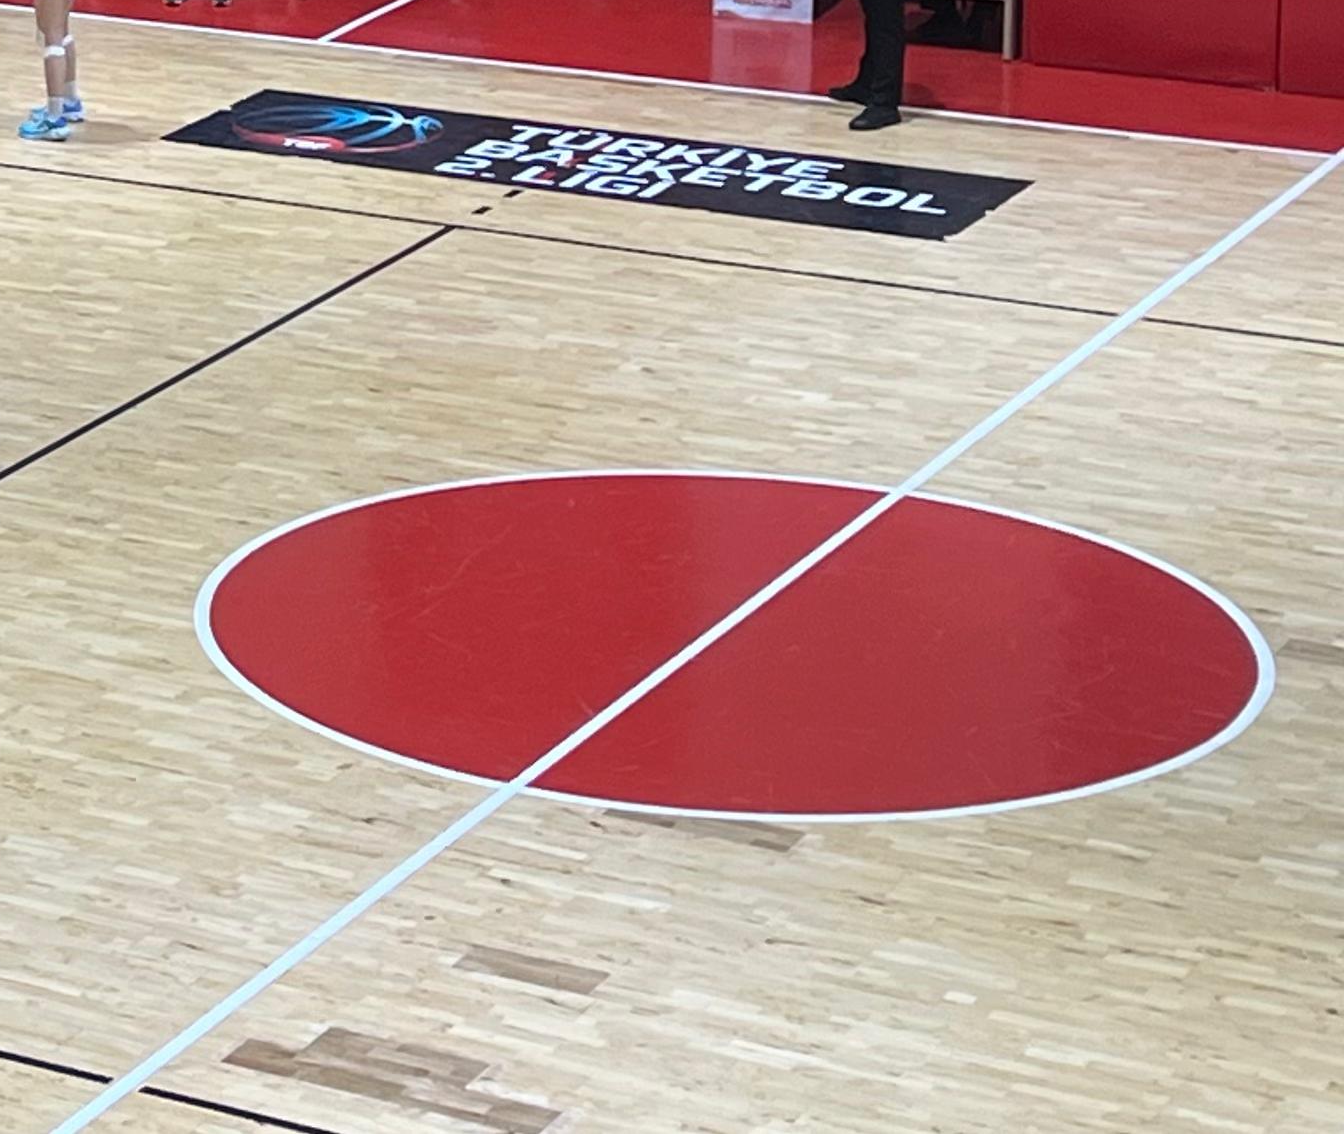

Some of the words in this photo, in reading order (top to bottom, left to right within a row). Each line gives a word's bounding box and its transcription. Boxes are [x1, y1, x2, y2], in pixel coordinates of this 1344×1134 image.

[434, 154, 496, 178] 2.
[463, 139, 948, 215] BASKETBOL
[511, 124, 845, 181] TÜRKİYE
